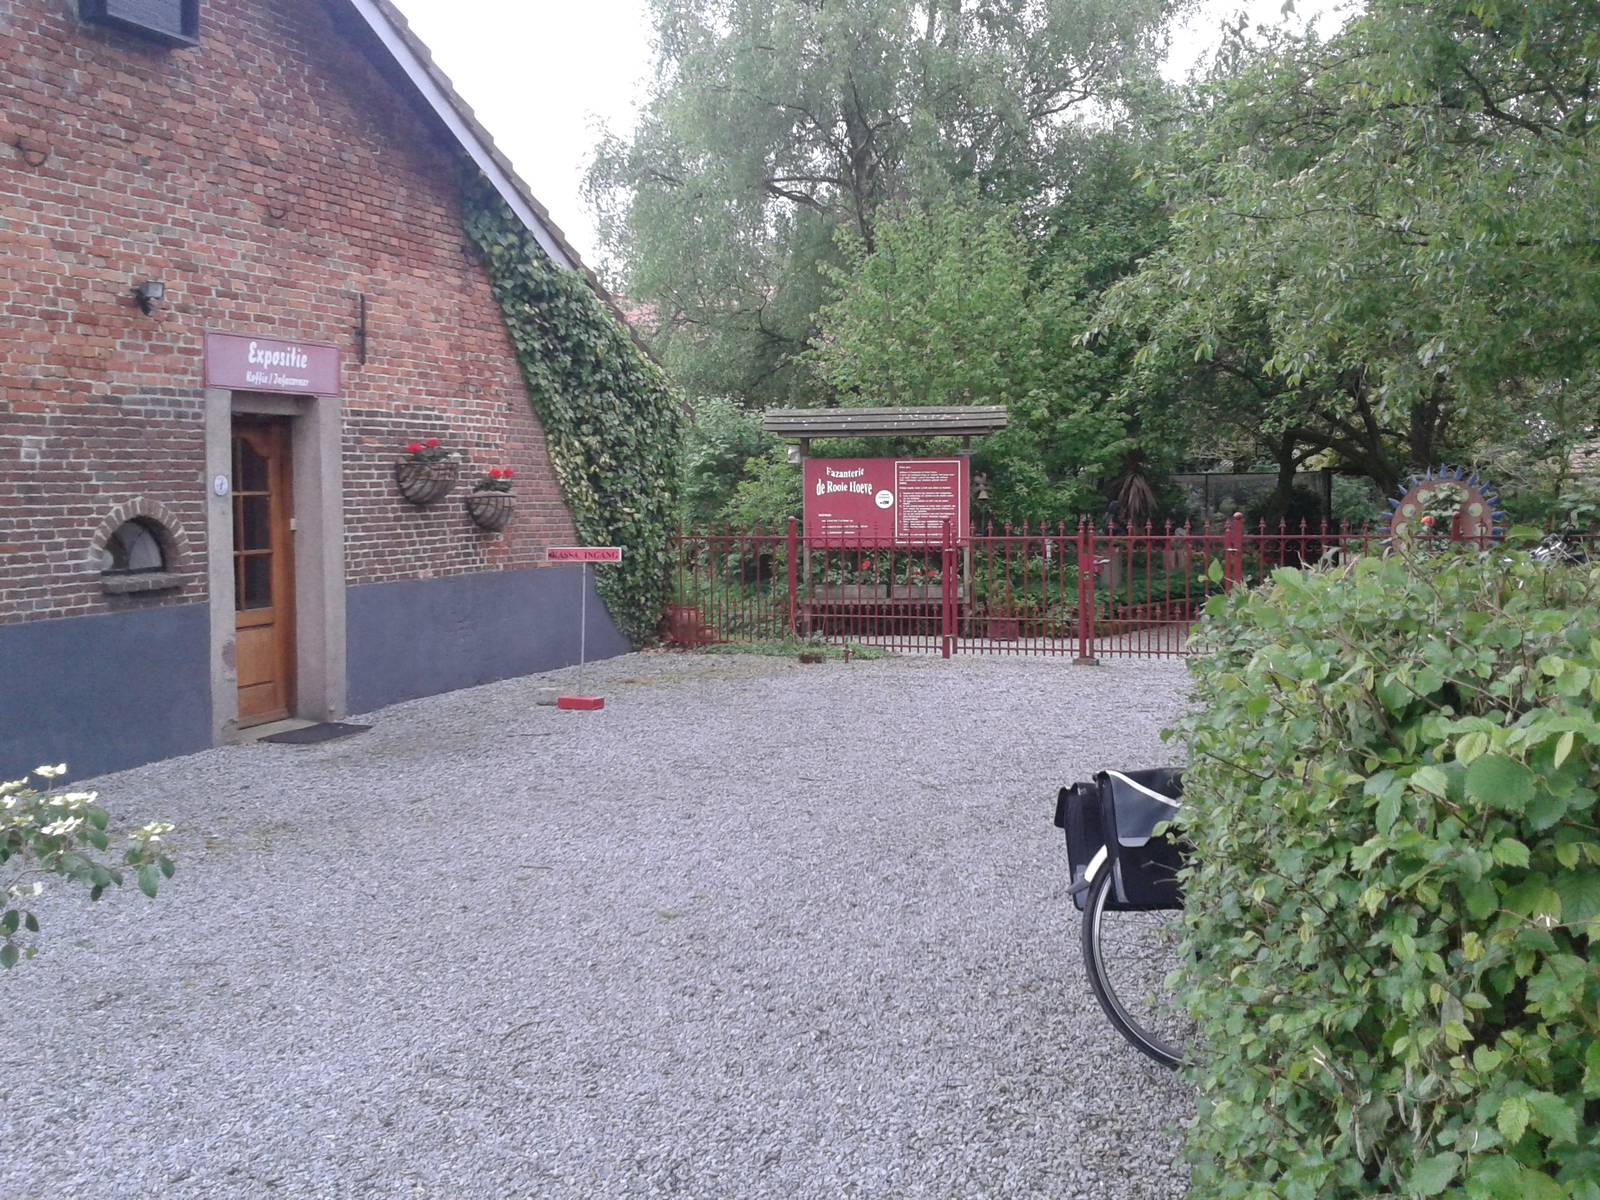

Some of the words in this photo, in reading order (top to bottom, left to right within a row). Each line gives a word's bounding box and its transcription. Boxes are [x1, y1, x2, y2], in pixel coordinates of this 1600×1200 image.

[248, 341, 308, 369] Expositie
[826, 466, 865, 478] Fazanterie
[816, 478, 826, 496] de
[827, 480, 848, 494] Rooie
[849, 481, 873, 496] Hoeve
[584, 550, 619, 560] INGANG
